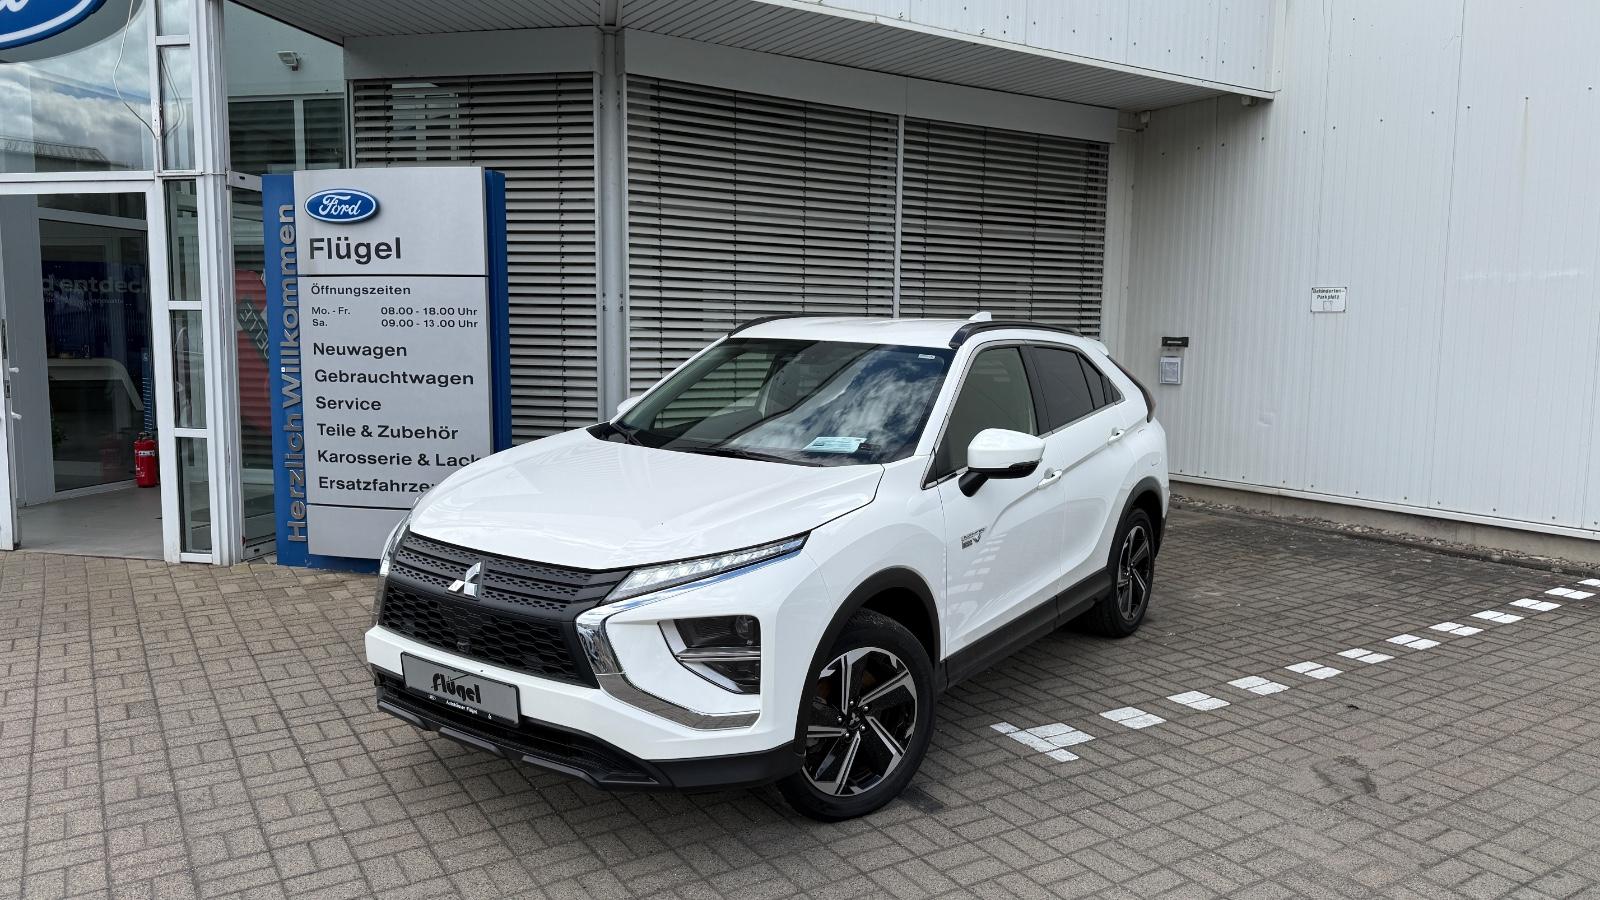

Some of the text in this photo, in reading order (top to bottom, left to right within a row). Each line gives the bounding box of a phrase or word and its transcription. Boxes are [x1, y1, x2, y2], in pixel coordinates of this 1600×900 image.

[318, 194, 361, 216] Ford
[309, 237, 402, 265] Flügel
[310, 283, 412, 297] Öffnungszeiten
[311, 306, 331, 315] Mo.
[338, 306, 351, 315] Fr.
[380, 306, 414, 316] 08.00
[423, 307, 455, 316] 18.00
[457, 307, 478, 316] Uhr
[312, 318, 328, 327] Sa.
[381, 319, 414, 328] 09.00
[458, 319, 479, 328] Uhr
[313, 343, 408, 359] Neuwagen
[278, 203, 307, 542] Herzlich Willkommen
[314, 369, 474, 388] Gebrauchtwagen
[315, 396, 382, 411] Service
[316, 423, 459, 440] Teile & Zubehör
[317, 450, 412, 466] Karosserie
[417, 453, 431, 466] &
[318, 476, 435, 493] Ersatzfahrze
